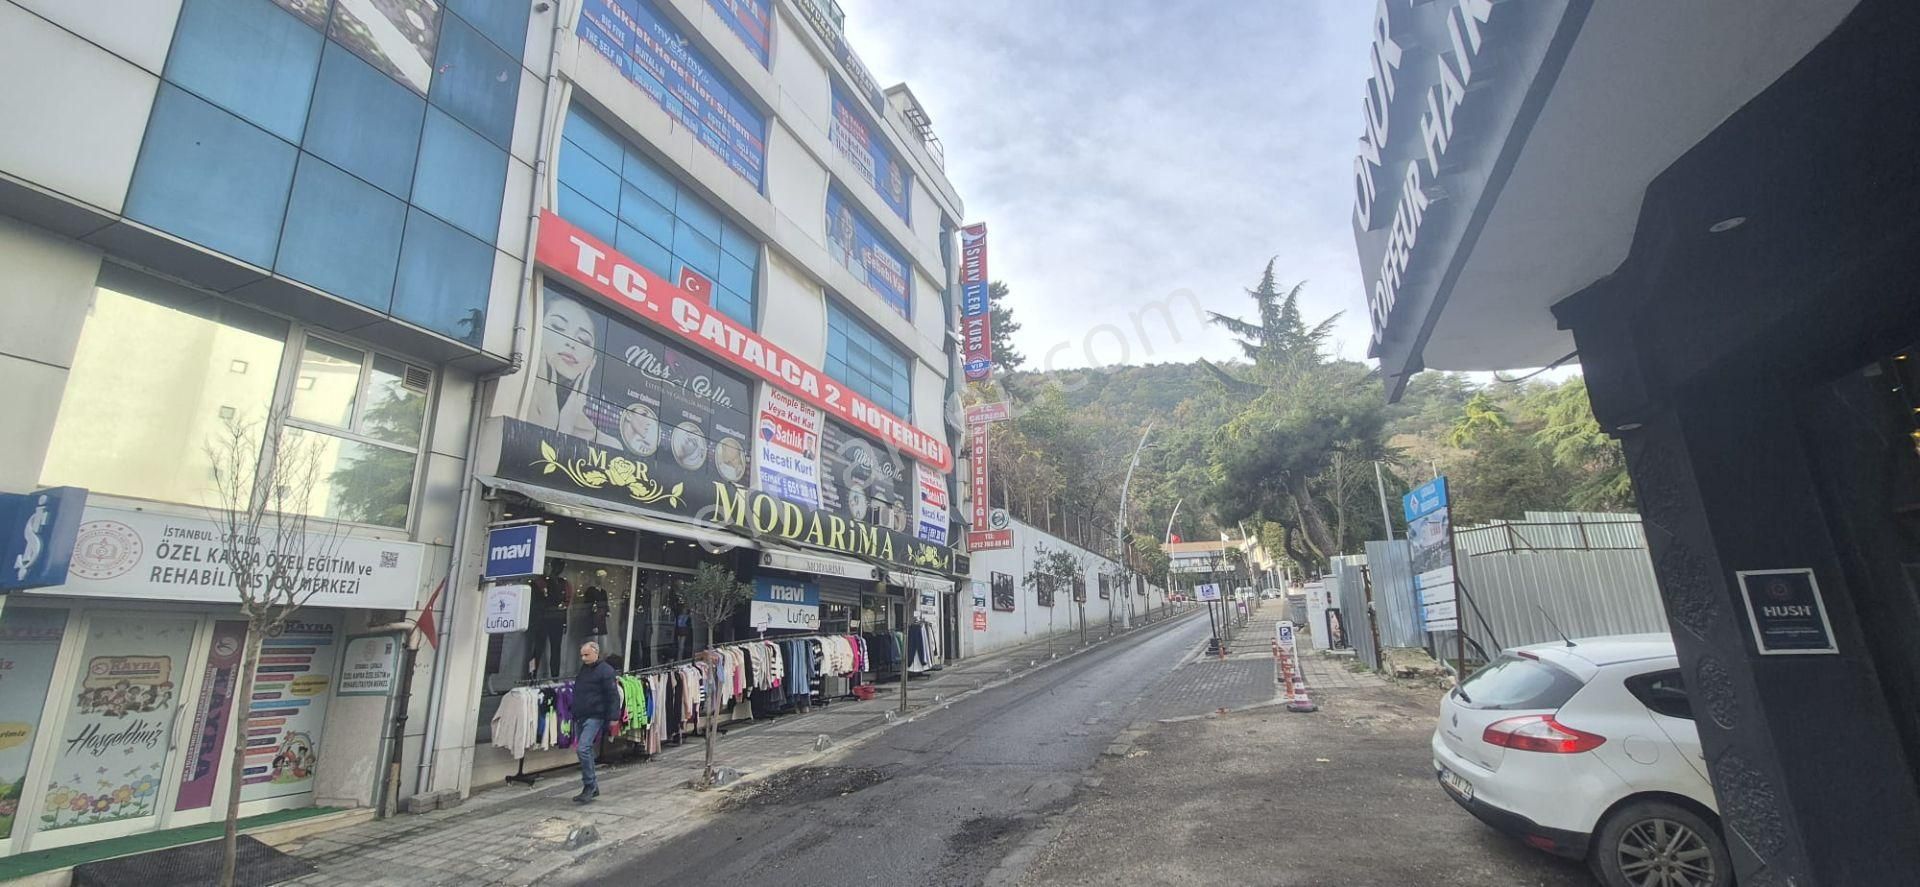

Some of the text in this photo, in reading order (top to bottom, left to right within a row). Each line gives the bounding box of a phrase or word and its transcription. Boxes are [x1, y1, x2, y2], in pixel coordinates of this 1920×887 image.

[1353, 0, 1403, 232] ONUR
[1371, 159, 1429, 345] COIFFEUR
[570, 235, 659, 312] T.C.
[671, 297, 819, 400] ÇATALCA
[823, 383, 847, 414] 2.
[968, 319, 982, 351] KURS
[768, 401, 814, 430] Veya Kat Kat
[771, 390, 815, 418] Komple Bina
[776, 424, 803, 449] Satılık
[763, 447, 813, 477] Necati Kurt
[163, 524, 213, 542] İSTANBUL
[156, 539, 202, 562] ÖZEL
[265, 550, 304, 569] ÖZEL
[307, 554, 355, 575] EĞİTİM
[357, 564, 373, 576] ve
[491, 538, 532, 560] mavi
[770, 584, 805, 602] mavi
[486, 616, 515, 629] Lufian
[1763, 605, 1812, 617] HUSH
